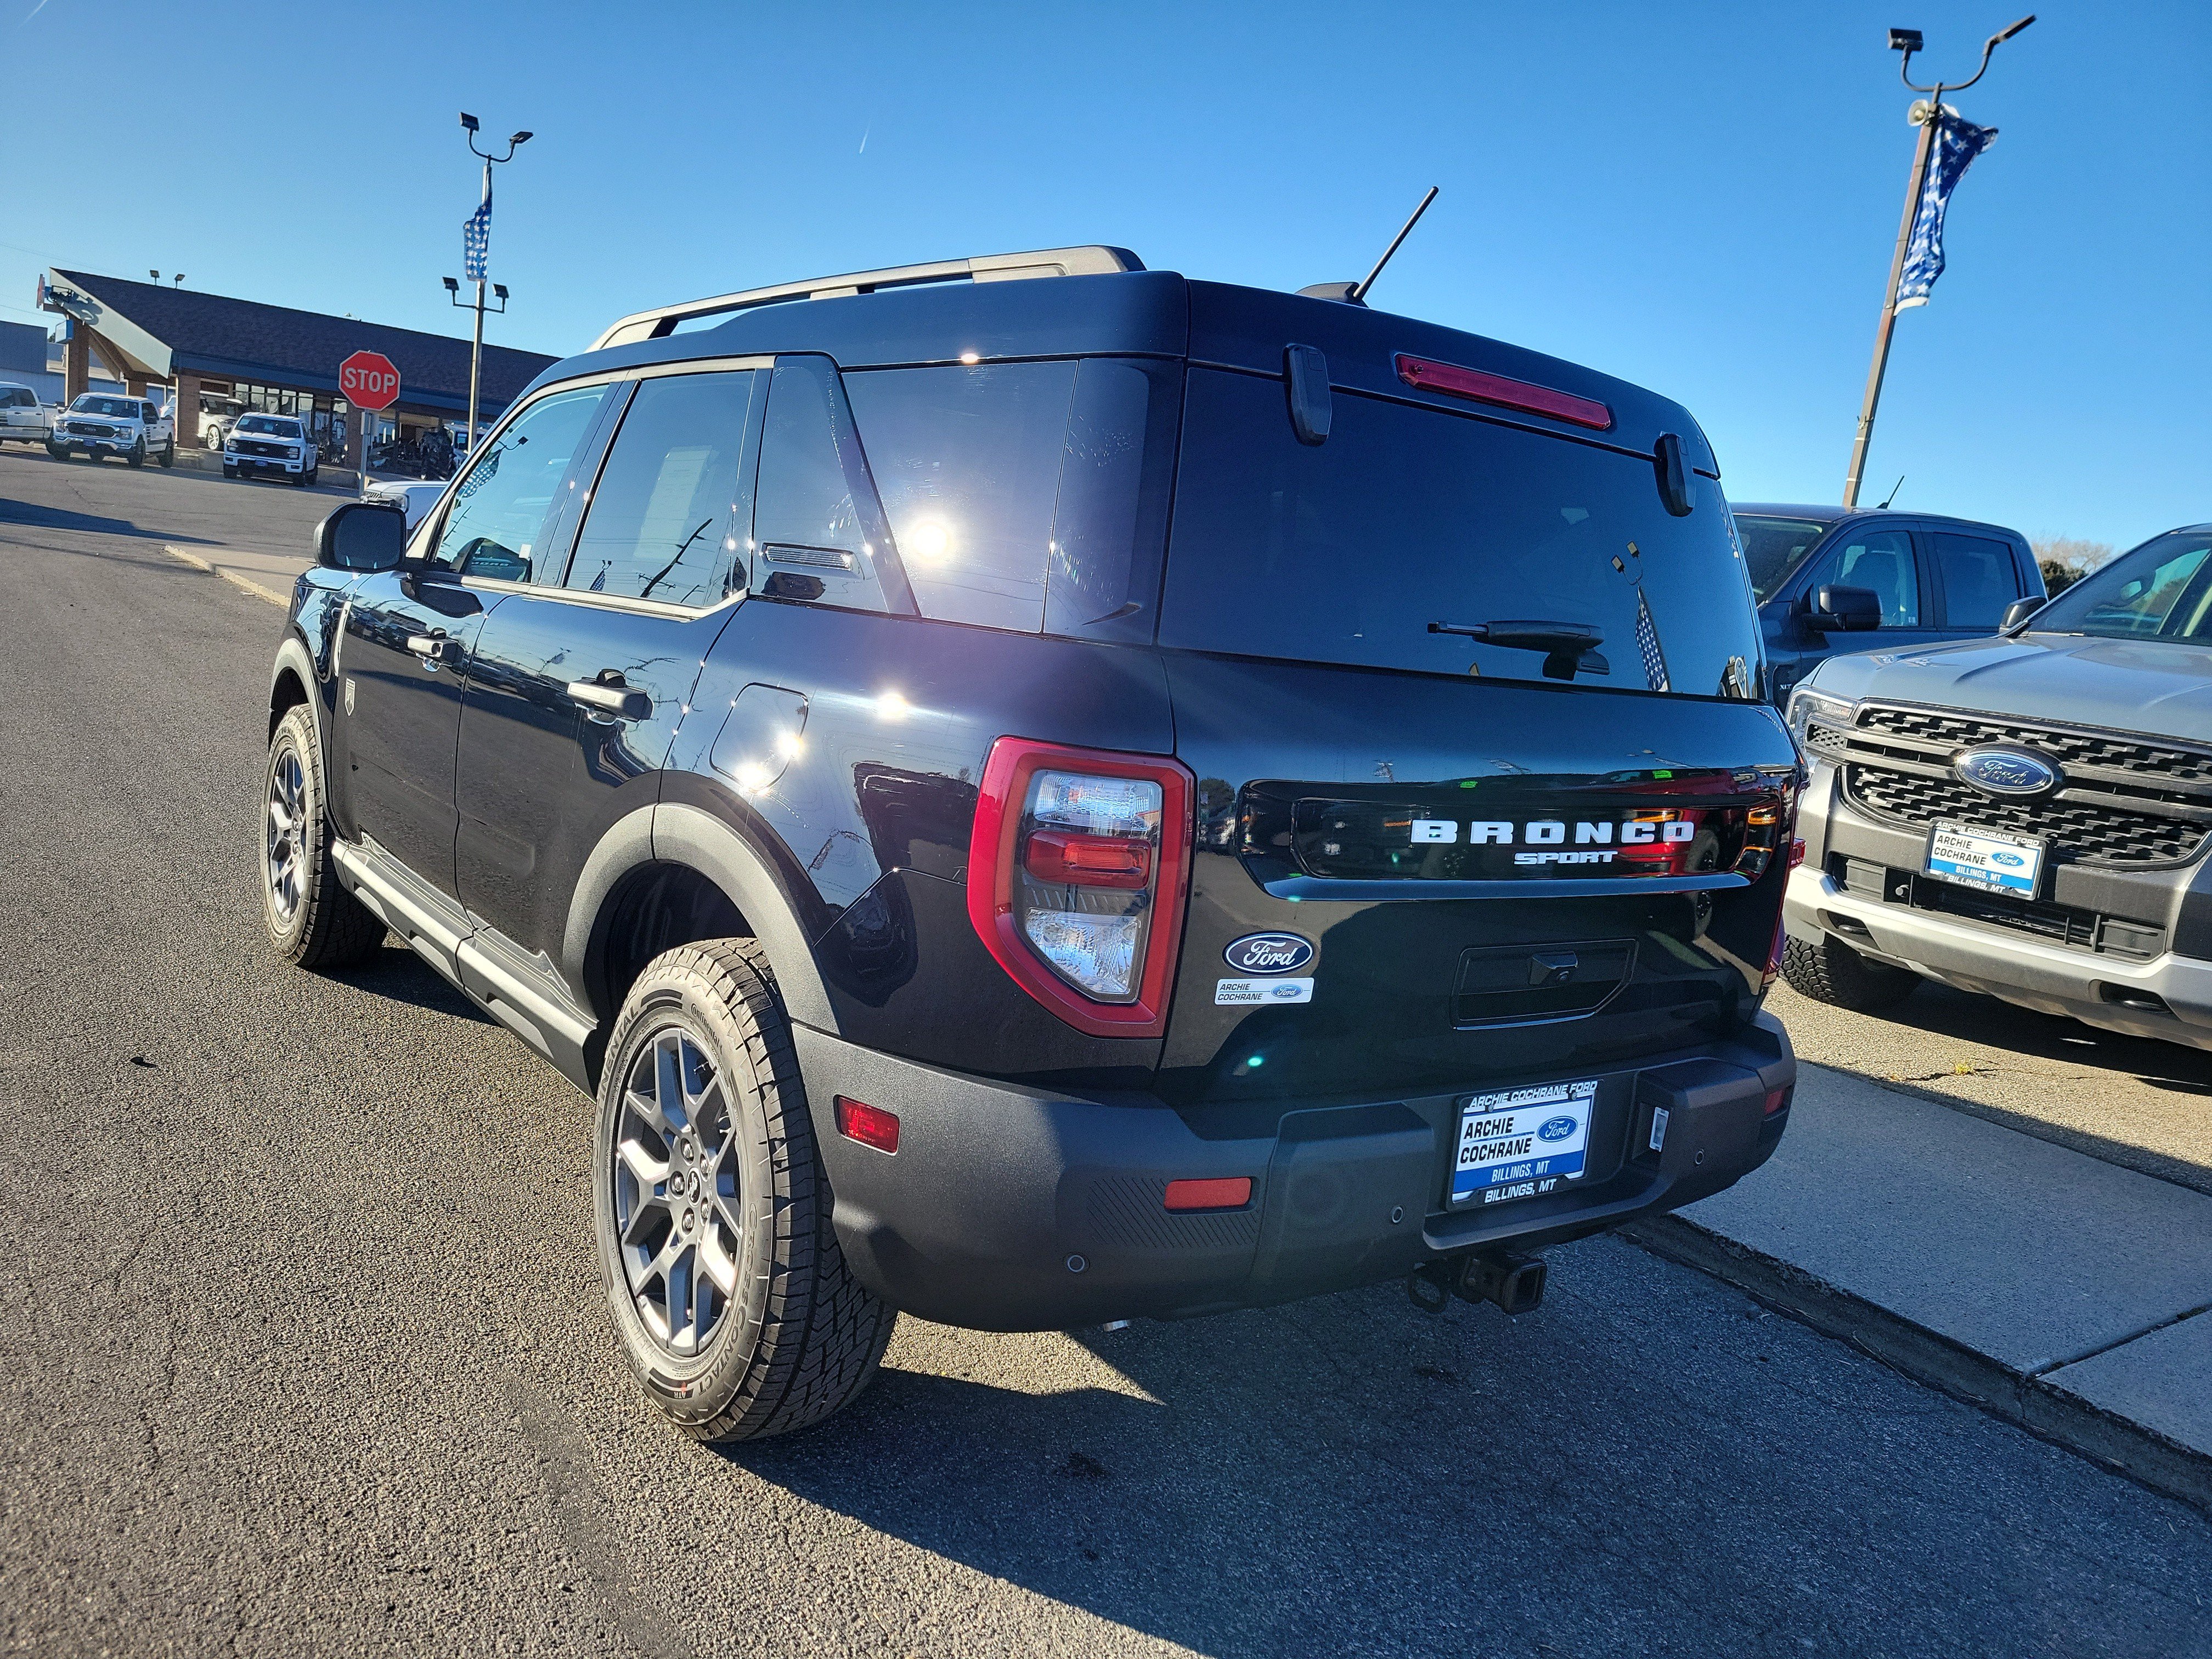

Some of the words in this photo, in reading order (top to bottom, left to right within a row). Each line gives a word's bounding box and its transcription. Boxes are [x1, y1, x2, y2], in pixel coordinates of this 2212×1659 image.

[344, 367, 396, 393] STOP
[1979, 760, 2029, 785] Ford
[1410, 820, 1694, 844] BRONCO
[1936, 821, 1966, 832] ARCHIE
[1967, 827, 2014, 842] COCHRANE
[2016, 837, 2040, 846] FORD
[1937, 835, 1972, 849] ARCHIE
[1514, 850, 1618, 865] SPORT
[1934, 847, 1987, 865] COCHRANE
[1997, 853, 2020, 865] Ford
[1948, 875, 1988, 890] BILLINGS,
[1990, 884, 2005, 893] MT
[1956, 866, 1988, 880] BILLINGS,
[1991, 874, 2002, 882] MT
[1243, 941, 1298, 966] Ford
[1277, 987, 1296, 996] Ford
[1469, 1092, 1509, 1108] ARCHIE
[1510, 1085, 1568, 1102] COCHRANE
[1569, 1080, 1598, 1093] FORD
[1464, 1117, 1514, 1139] ARCHIE
[1545, 1121, 1570, 1138] Ford
[1460, 1138, 1532, 1164] COCHRANE
[1491, 1163, 1533, 1182] BILLINGS,
[1536, 1160, 1550, 1173] MT
[1484, 1182, 1535, 1203] BILLINGS,
[1538, 1179, 1557, 1193] MT
